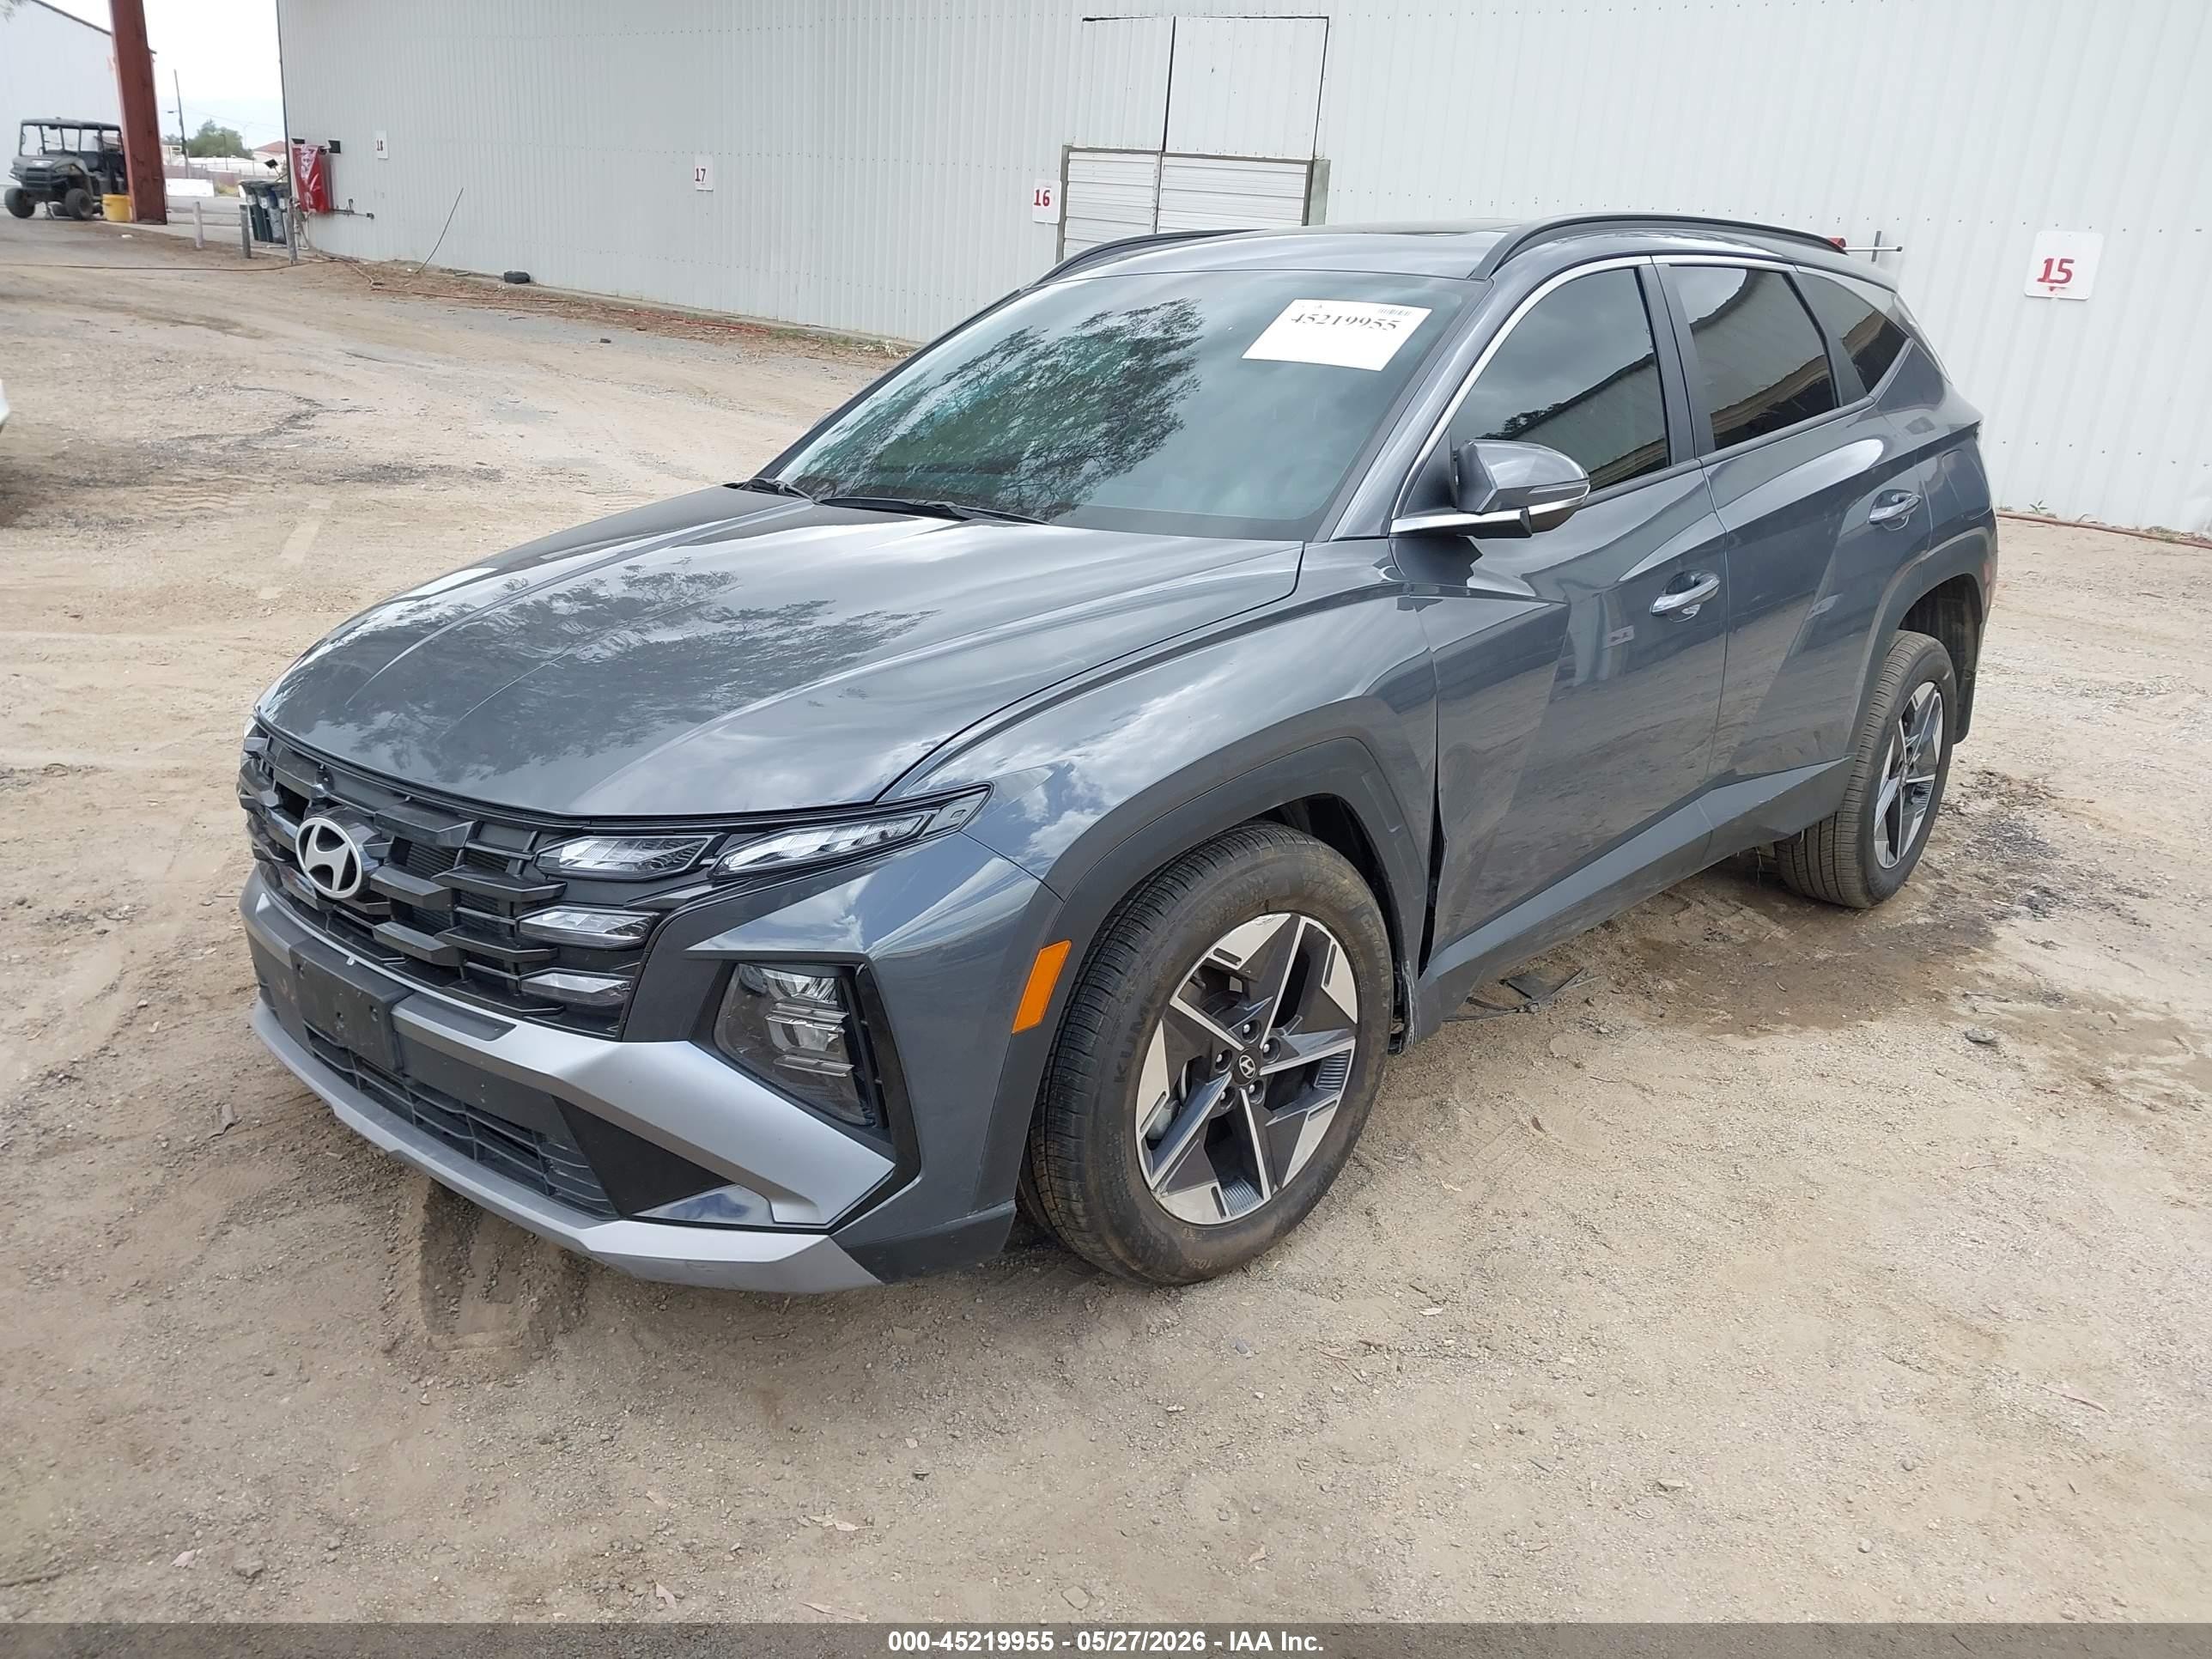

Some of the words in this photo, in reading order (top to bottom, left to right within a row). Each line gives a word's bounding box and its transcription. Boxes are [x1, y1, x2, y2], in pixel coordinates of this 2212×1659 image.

[695, 167, 706, 182] 17
[1033, 189, 1051, 207] 16
[2037, 258, 2075, 284] 15
[1291, 313, 1401, 331] 45219955
